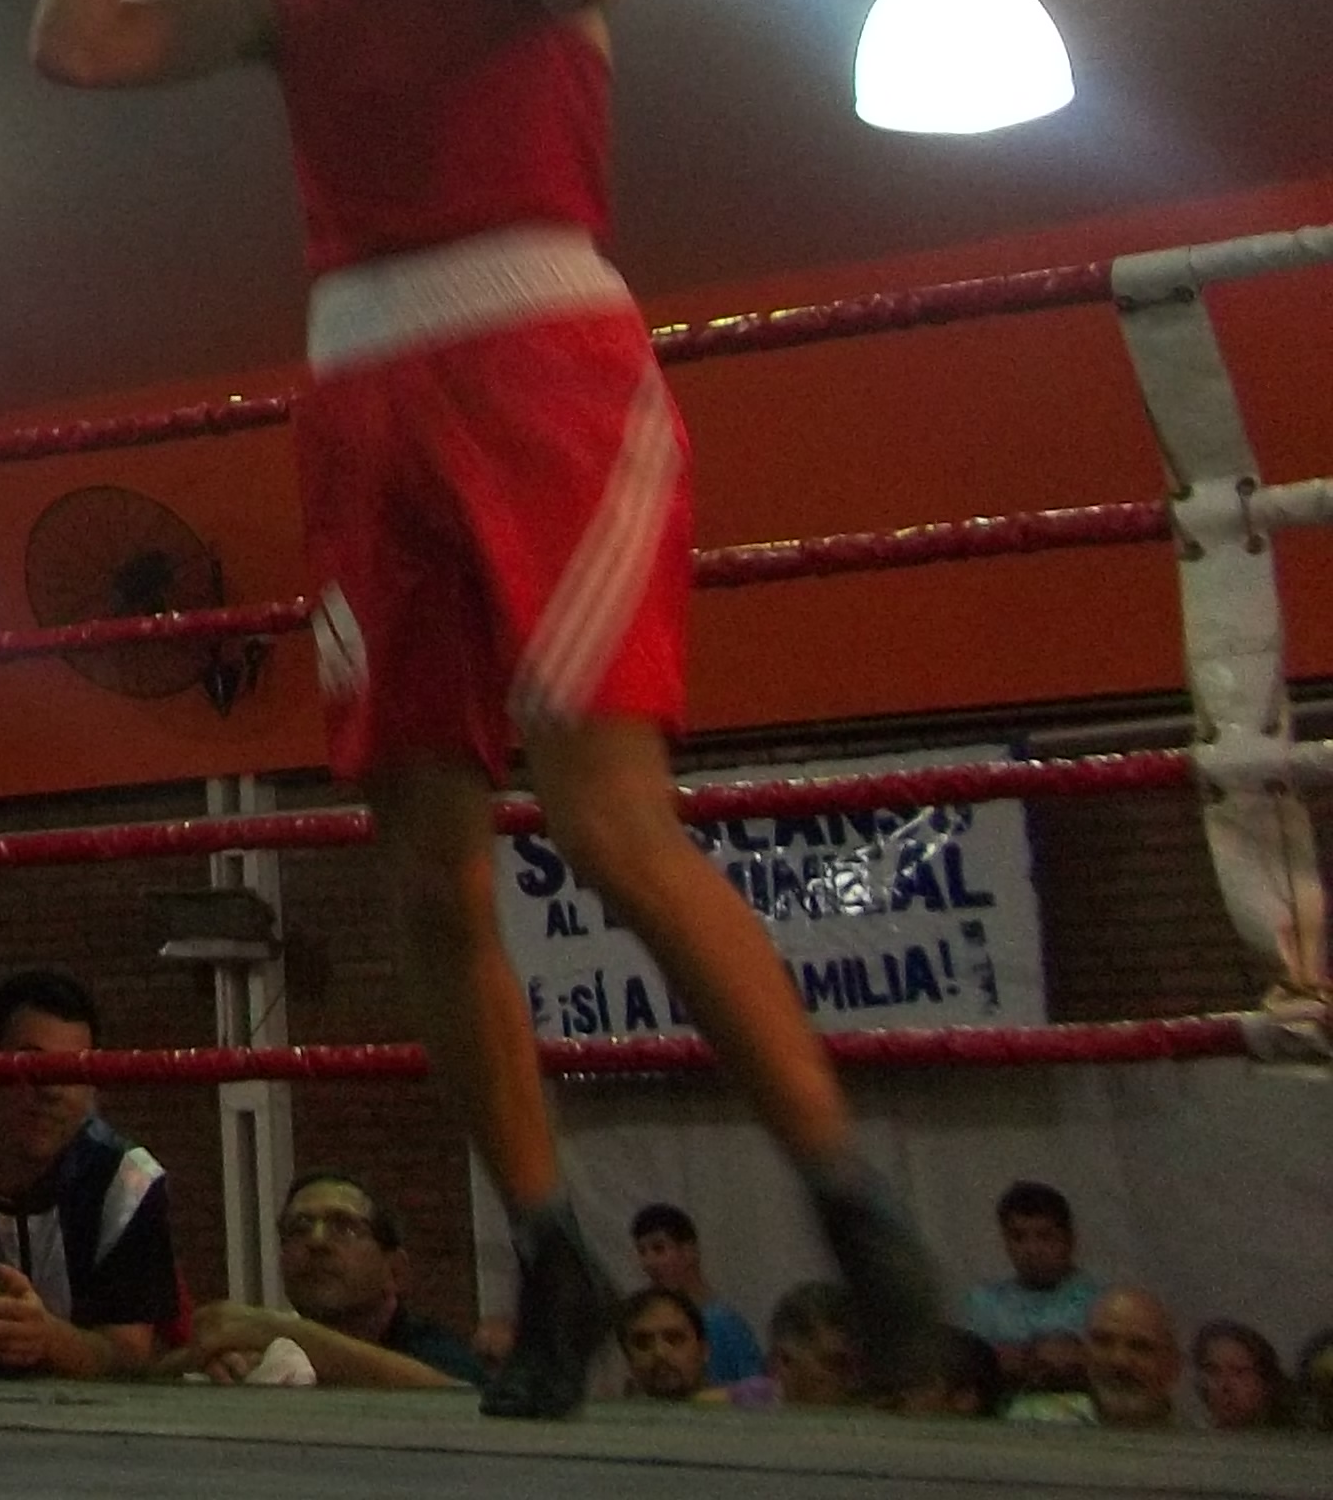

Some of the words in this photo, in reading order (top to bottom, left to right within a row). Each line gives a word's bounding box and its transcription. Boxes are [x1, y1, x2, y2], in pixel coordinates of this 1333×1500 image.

[546, 901, 589, 937] AL
[626, 976, 659, 1031] A
[787, 940, 960, 1013] MILIA!
